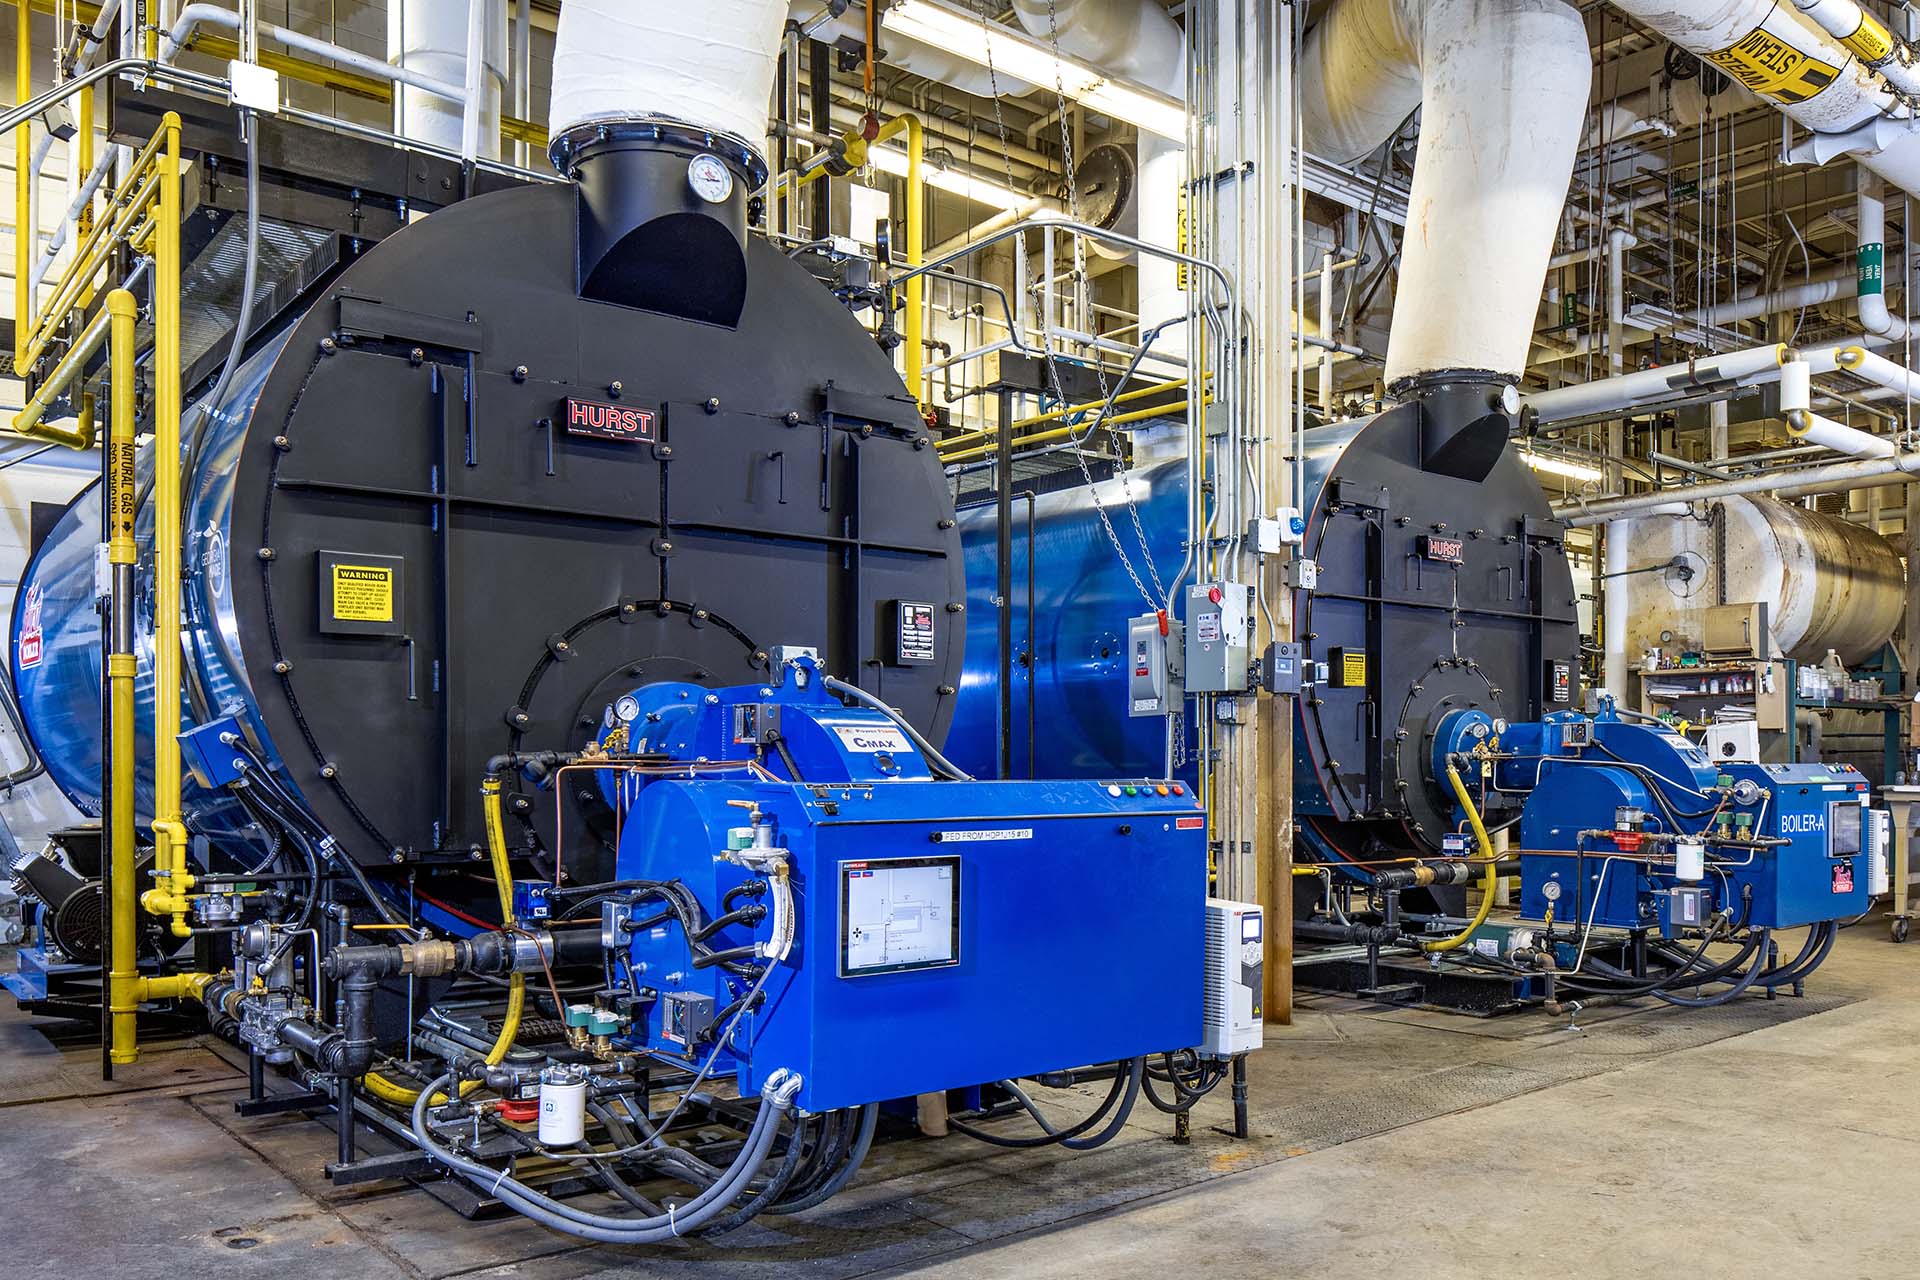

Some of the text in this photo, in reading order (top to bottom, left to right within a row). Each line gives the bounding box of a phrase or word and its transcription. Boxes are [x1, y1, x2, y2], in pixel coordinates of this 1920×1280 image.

[1738, 32, 1797, 75] STEAM
[1710, 50, 1771, 87] STEAM
[572, 404, 651, 433] HURST
[121, 443, 133, 514] NATURAL GAS
[1430, 541, 1461, 557] HURST
[340, 571, 385, 580] WARNING
[944, 832, 960, 840] FED
[962, 831, 983, 840] FROM
[1781, 814, 1825, 833] BOILER-A
